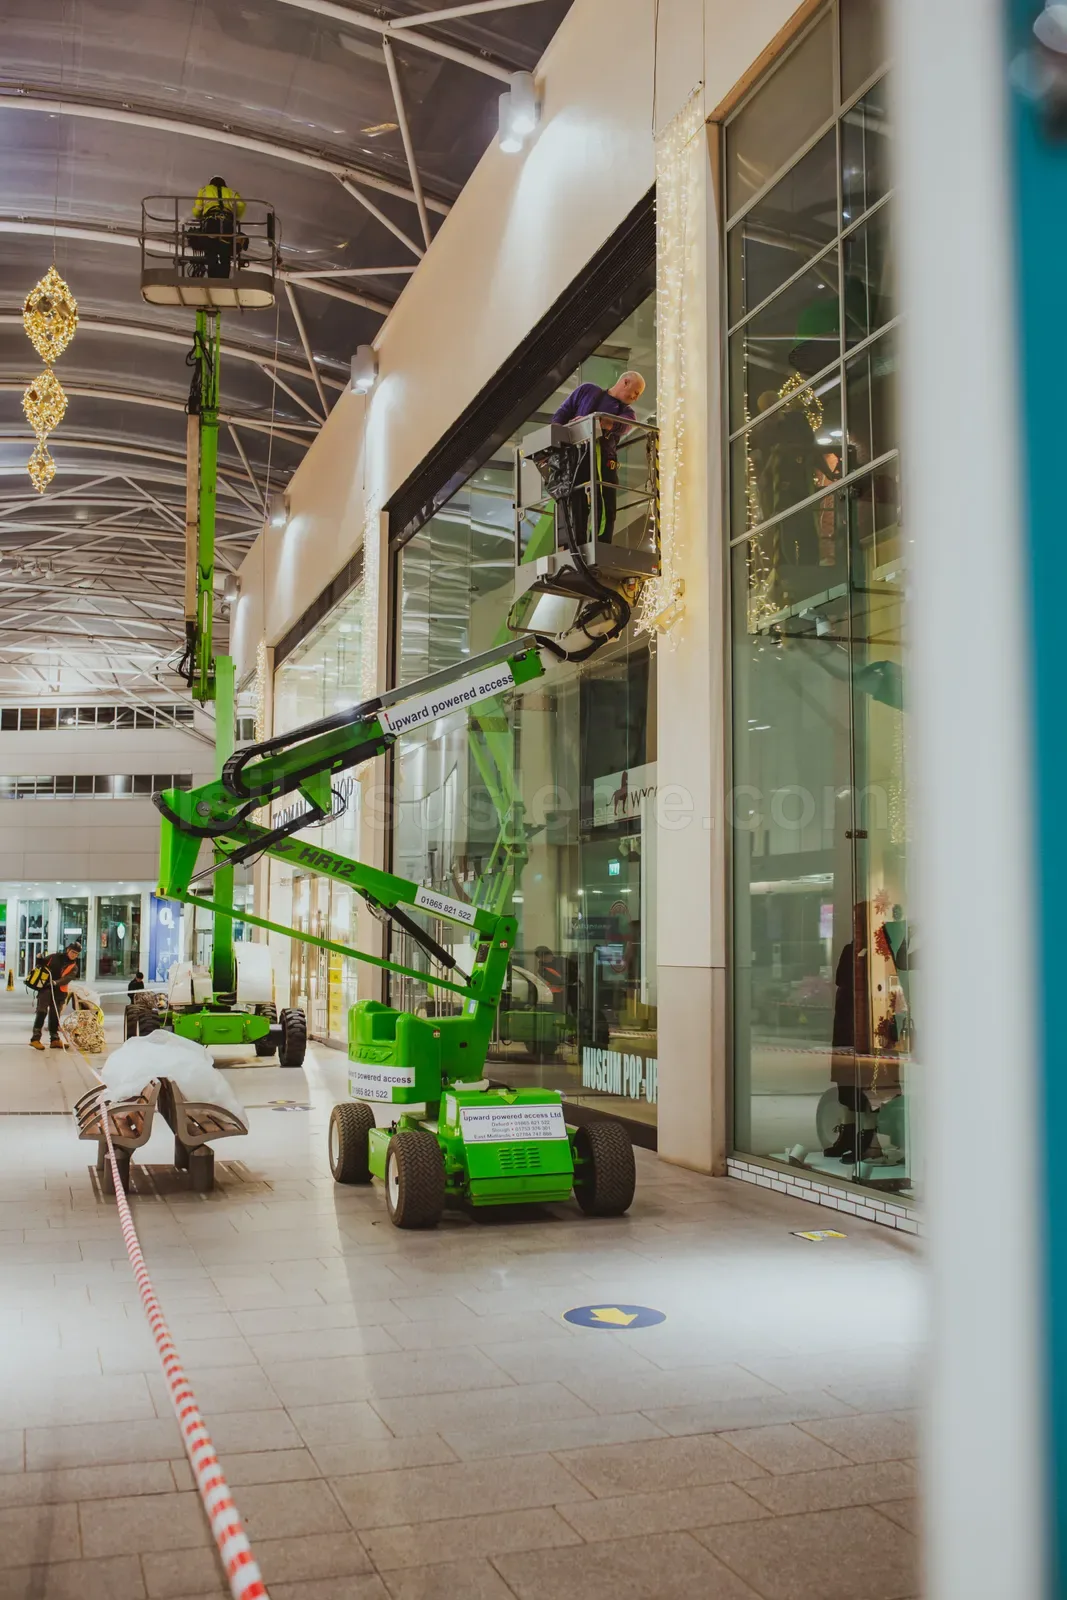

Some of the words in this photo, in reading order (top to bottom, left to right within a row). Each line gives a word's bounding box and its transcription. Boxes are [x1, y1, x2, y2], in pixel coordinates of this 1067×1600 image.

[387, 705, 430, 733] upward
[431, 687, 477, 713] powered
[479, 674, 514, 696] access
[299, 847, 356, 879] HR12
[420, 895, 442, 910] 01865
[443, 905, 457, 915] 821
[458, 911, 472, 921] 522
[357, 1072, 381, 1082] powered
[383, 1076, 412, 1084] access
[582, 1046, 621, 1096] MUSEUM
[364, 1089, 374, 1097] 821
[376, 1090, 388, 1098] 522
[463, 1114, 490, 1122] upward
[491, 1113, 522, 1121] powered
